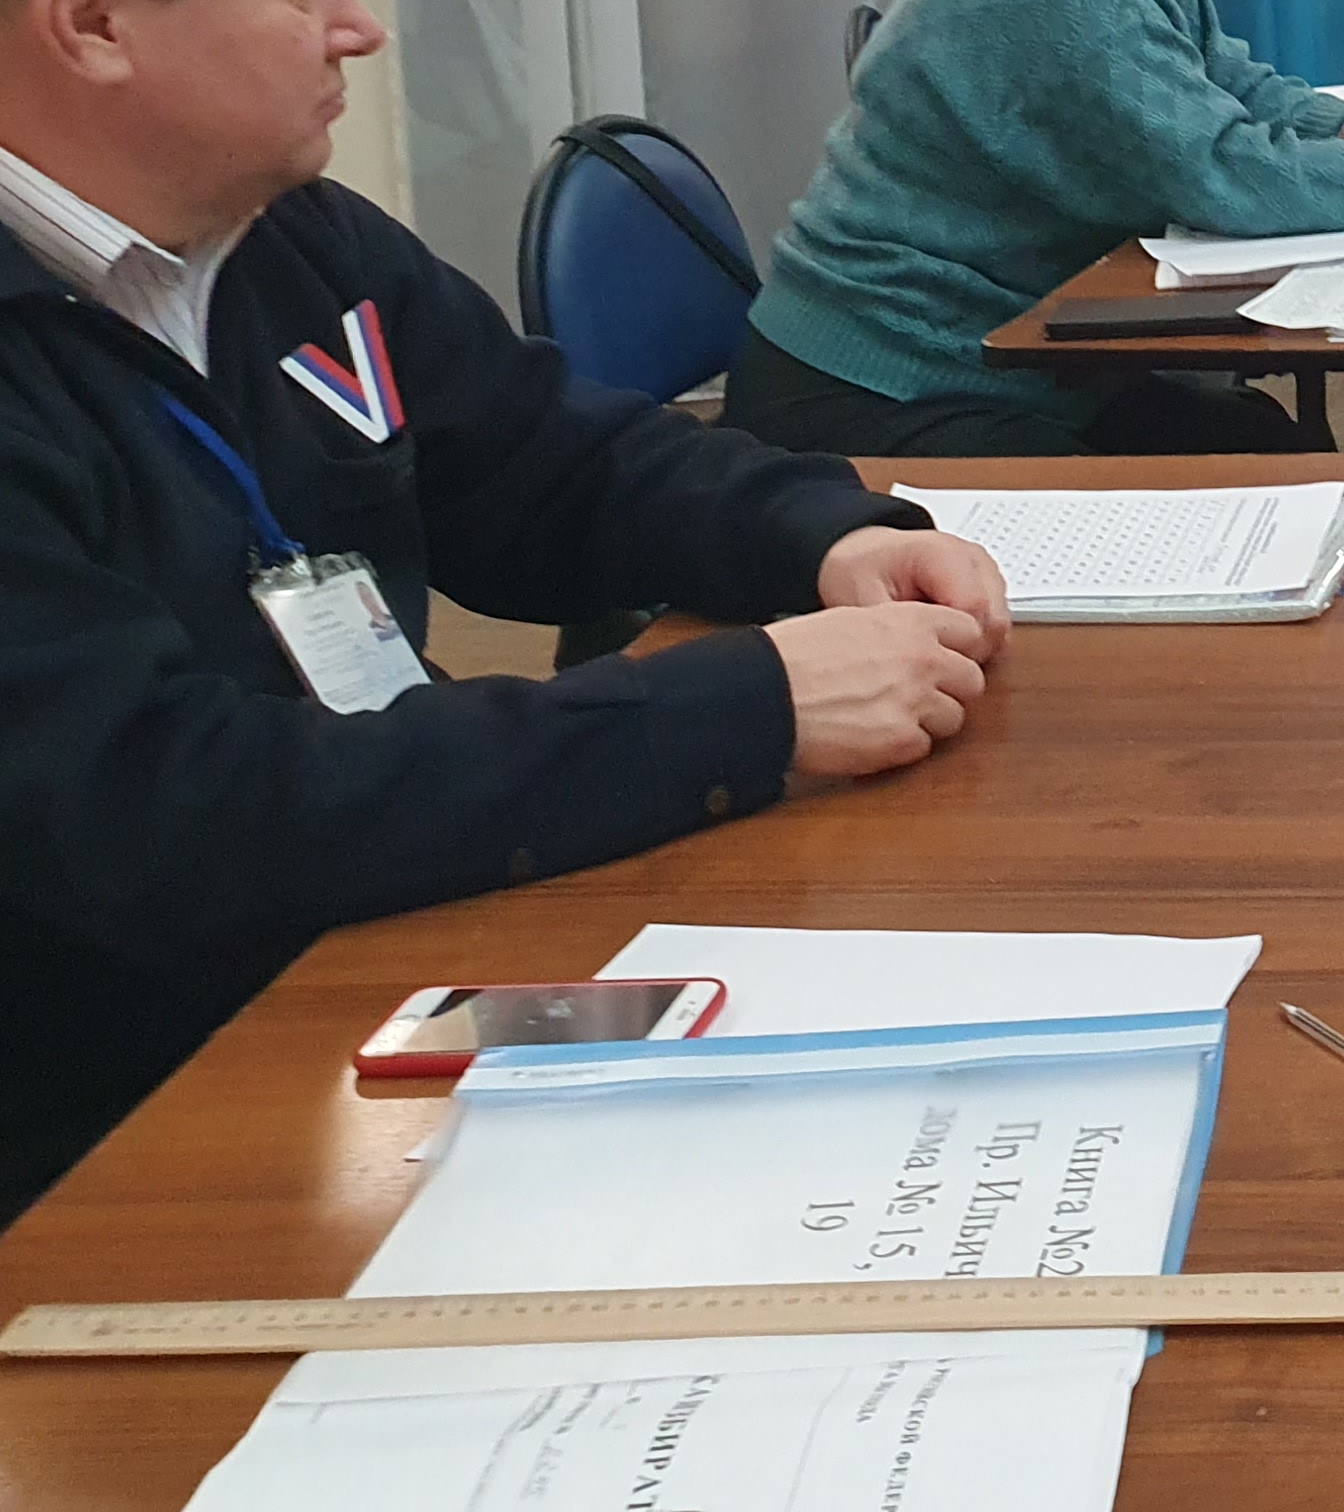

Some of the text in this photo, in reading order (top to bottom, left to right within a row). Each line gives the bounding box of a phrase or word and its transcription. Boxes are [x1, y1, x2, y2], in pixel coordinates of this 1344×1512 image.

[974, 1120, 1042, 1169] Пр.
[1052, 1124, 1124, 1217] Книга
[800, 1198, 856, 1234] 19
[885, 1179, 943, 1216] №
[852, 1225, 924, 1271] 15,
